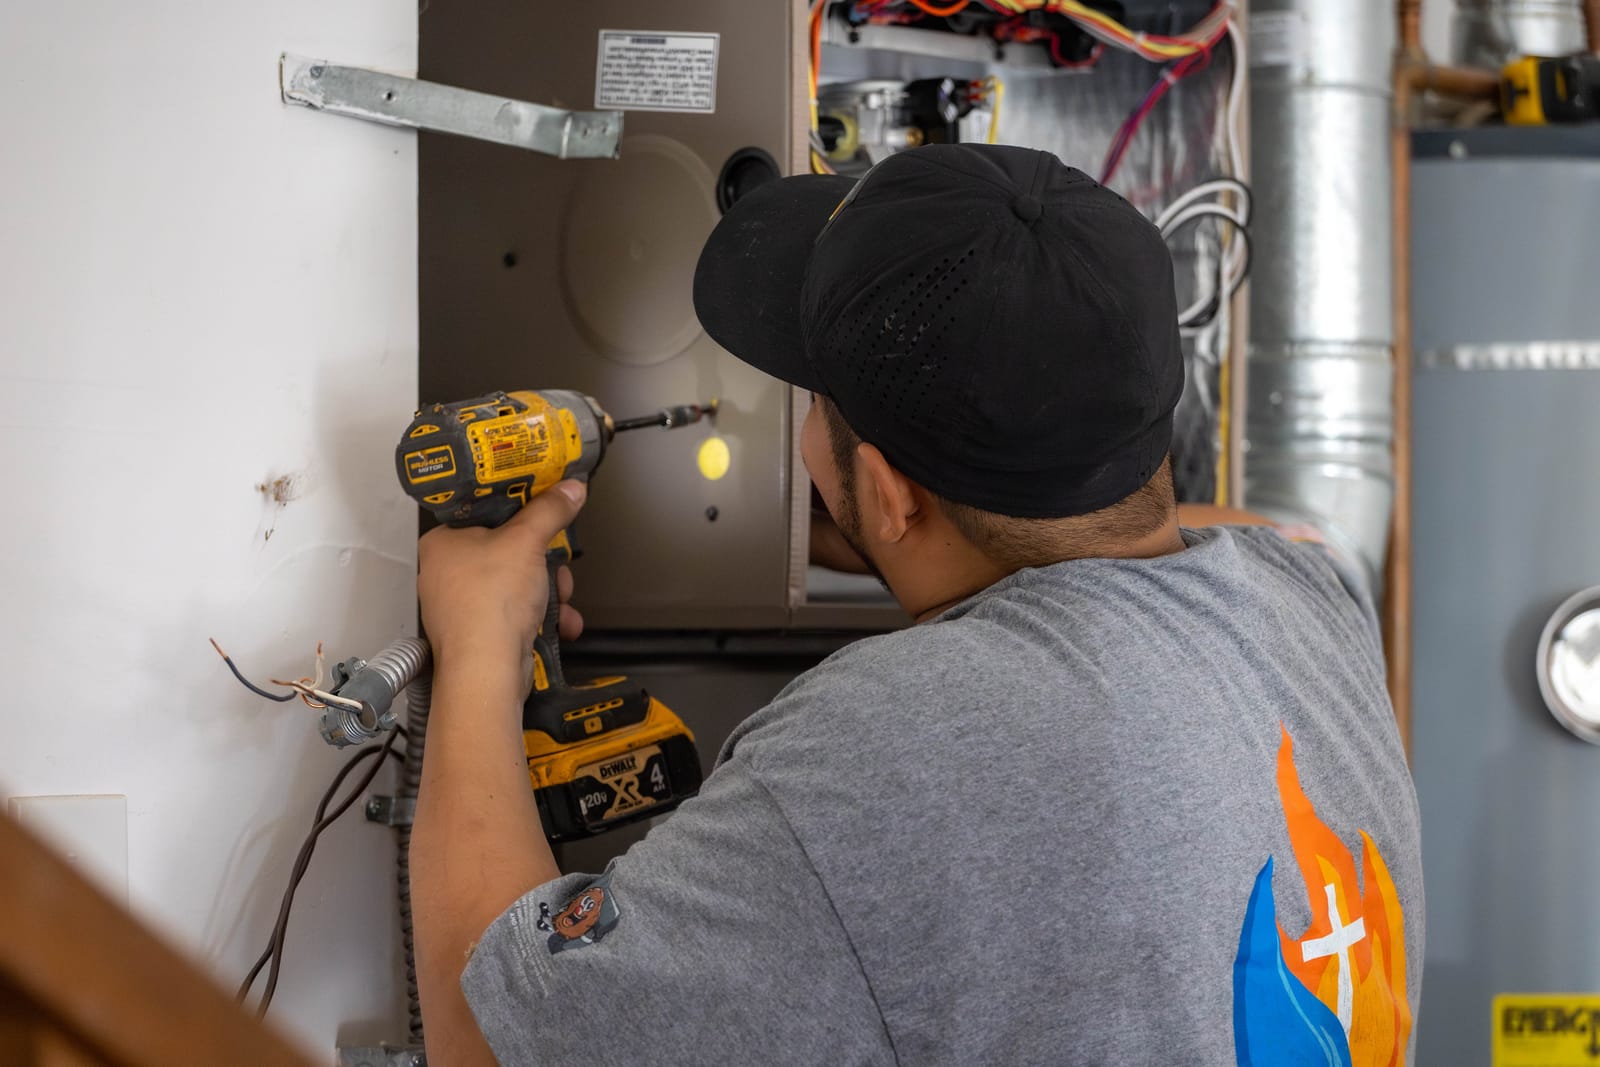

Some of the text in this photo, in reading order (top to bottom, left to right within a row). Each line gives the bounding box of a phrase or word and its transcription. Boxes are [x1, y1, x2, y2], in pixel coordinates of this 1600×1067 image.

[418, 464, 444, 473] MOTOR
[651, 763, 664, 784] 4
[604, 775, 651, 814] XR
